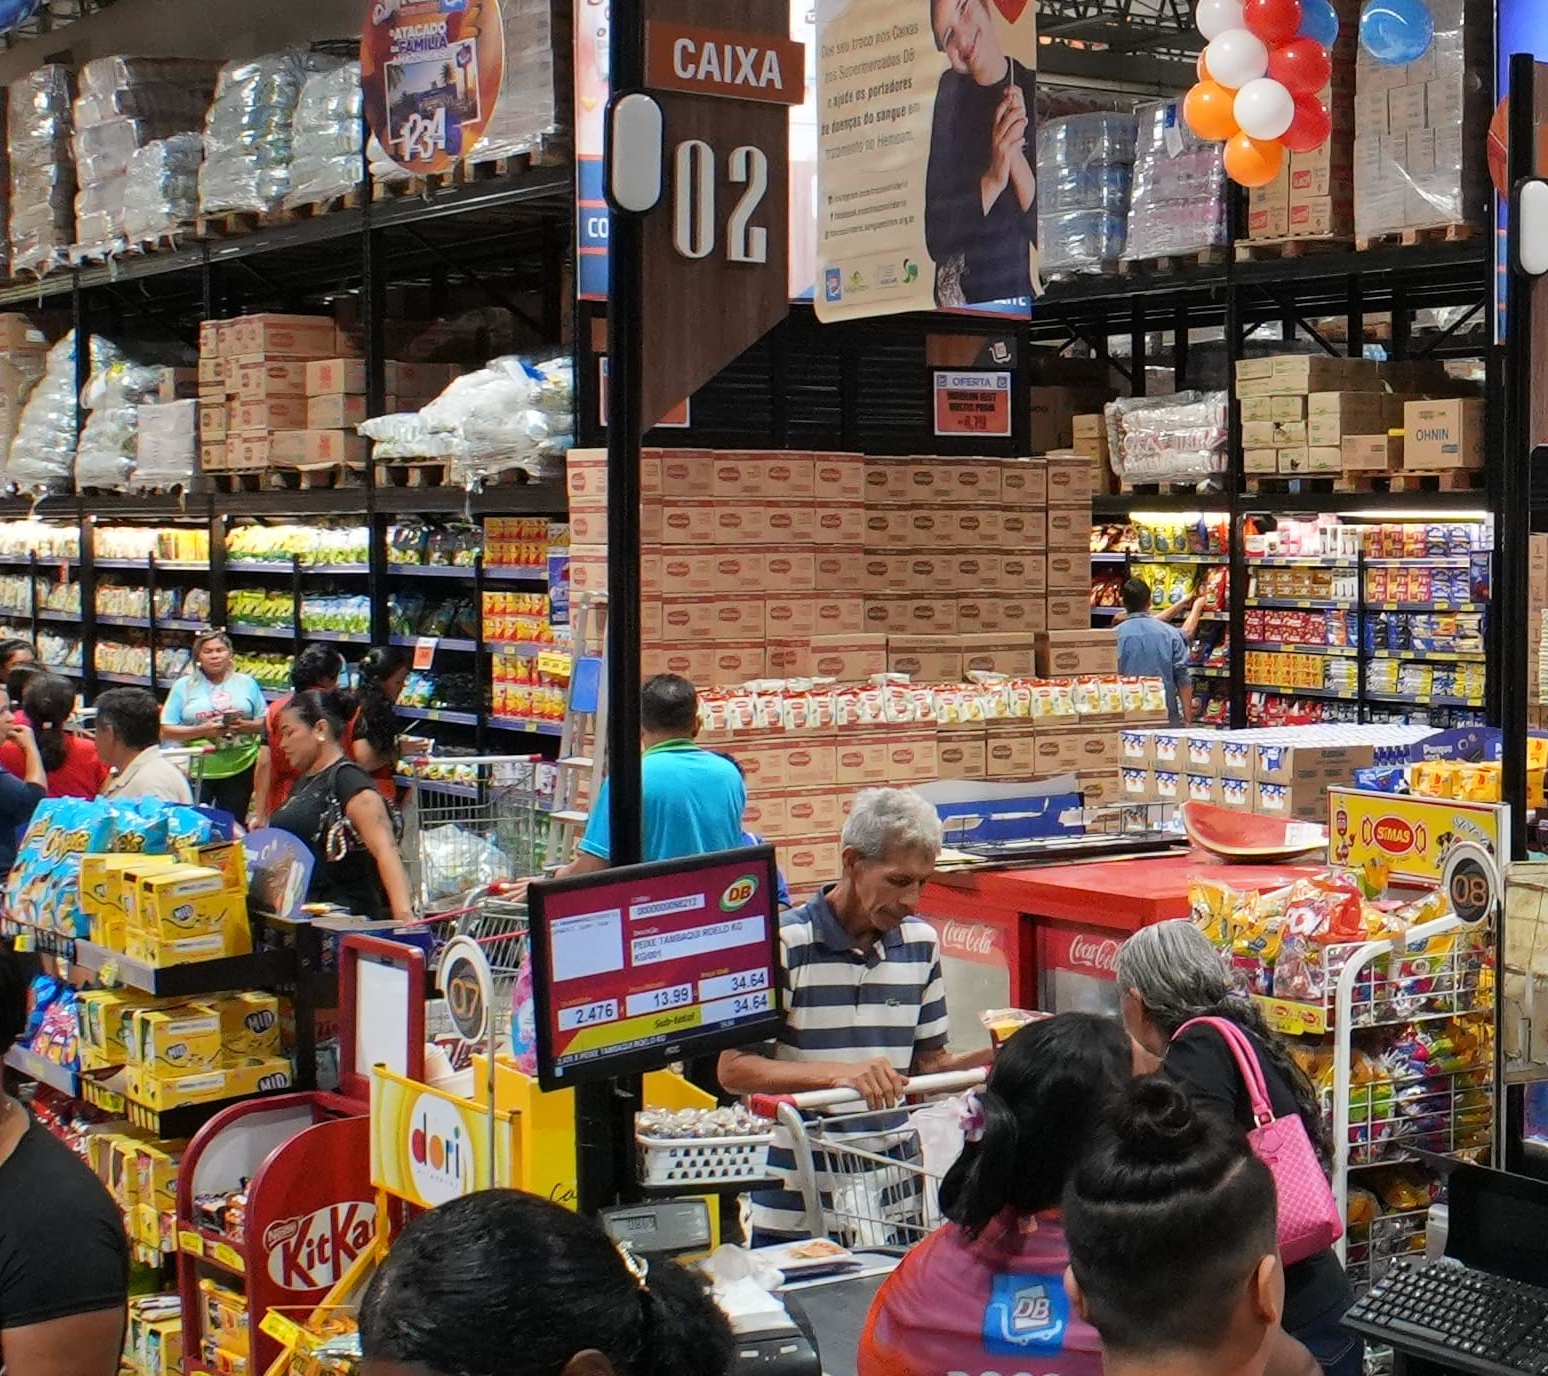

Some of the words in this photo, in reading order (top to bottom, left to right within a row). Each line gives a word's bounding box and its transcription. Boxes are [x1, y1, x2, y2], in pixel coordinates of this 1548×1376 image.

[673, 37, 783, 91] CAIXA
[868, 75, 913, 100] portadores
[673, 139, 768, 264] 02
[952, 377, 992, 387] OFERTA
[1416, 426, 1450, 441] OHNIN
[727, 885, 752, 903] DB
[1453, 876, 1488, 908] 08
[450, 975, 482, 1018] 07
[653, 987, 690, 1008] 13.99
[246, 1010, 275, 1033] MID
[575, 1003, 614, 1024] 2.476
[411, 1110, 462, 1180] dori
[282, 1201, 384, 1289] KitKa
[1014, 1291, 1051, 1321] DB
